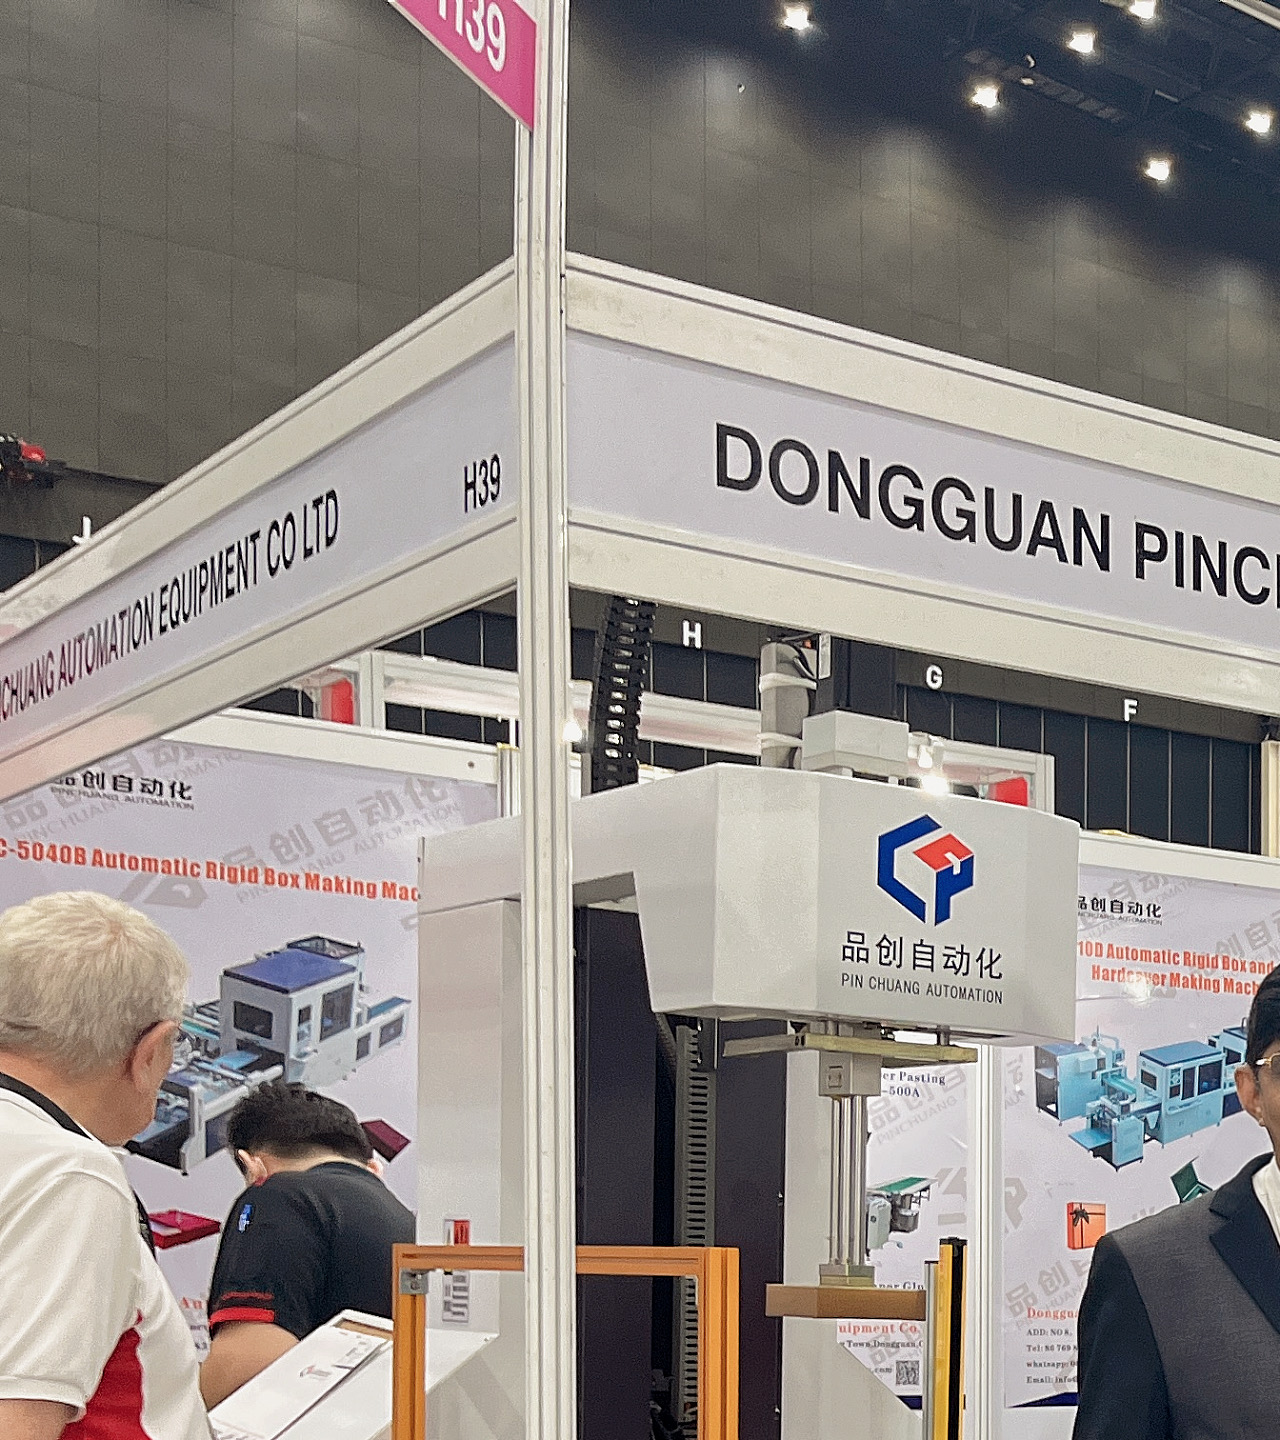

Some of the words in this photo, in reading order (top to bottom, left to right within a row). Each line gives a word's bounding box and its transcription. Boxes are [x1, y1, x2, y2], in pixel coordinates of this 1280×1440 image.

[463, 453, 502, 513] H39
[715, 422, 1111, 573] DONGGUAN
[58, 596, 156, 693] AUTOMATION
[158, 529, 263, 634] EQUIPMENT
[267, 512, 297, 579] CO
[303, 489, 340, 562] LTD
[683, 621, 701, 649] H
[926, 665, 943, 691] G
[1123, 699, 1138, 723] F
[91, 847, 201, 878] Automatic
[205, 861, 260, 888] Rigid
[264, 868, 300, 891] Box
[305, 873, 378, 902] Making
[841, 930, 1004, 980] 品创自动化
[1106, 943, 1181, 967] Automatic
[1183, 951, 1219, 971] Rigid
[1222, 956, 1247, 974] Box
[1249, 959, 1274, 976] and
[841, 972, 864, 989] PIN
[868, 975, 921, 996] CHUANG
[925, 982, 1004, 1005] AUTOMATION
[1170, 971, 1221, 994] Making
[900, 1070, 946, 1086] Pasting
